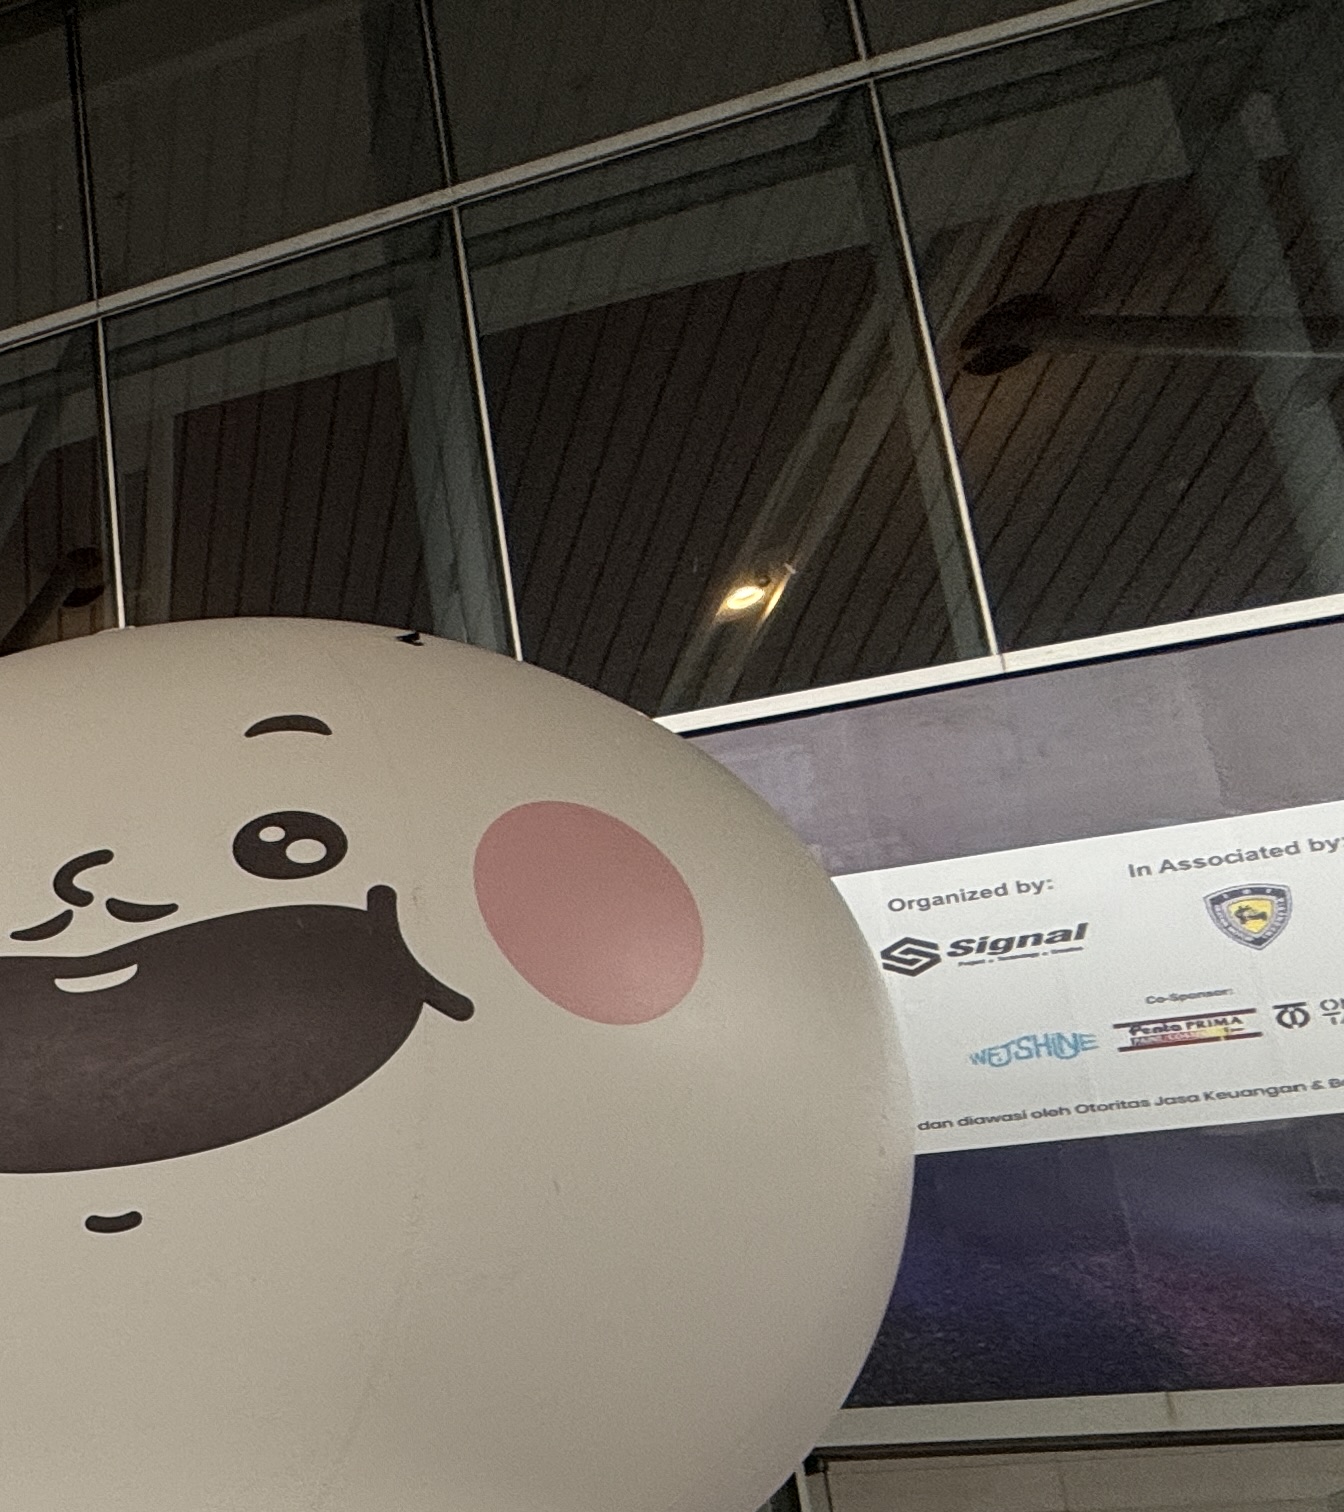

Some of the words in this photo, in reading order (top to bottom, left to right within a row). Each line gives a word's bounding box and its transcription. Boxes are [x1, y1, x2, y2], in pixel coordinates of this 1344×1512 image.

[1128, 862, 1152, 878] In
[1158, 840, 1301, 875] Associated
[887, 882, 1008, 913] Organized
[1015, 878, 1055, 900] by:
[947, 921, 1089, 957] Signal
[1185, 1016, 1244, 1032] PRIMA
[917, 1117, 954, 1132] dan
[957, 1108, 1028, 1128] diawasi
[1030, 1104, 1071, 1121] oleh
[1075, 1093, 1151, 1115] Otoritas
[1154, 1089, 1200, 1108] Jasa
[1203, 1081, 1307, 1103] Keuangan
